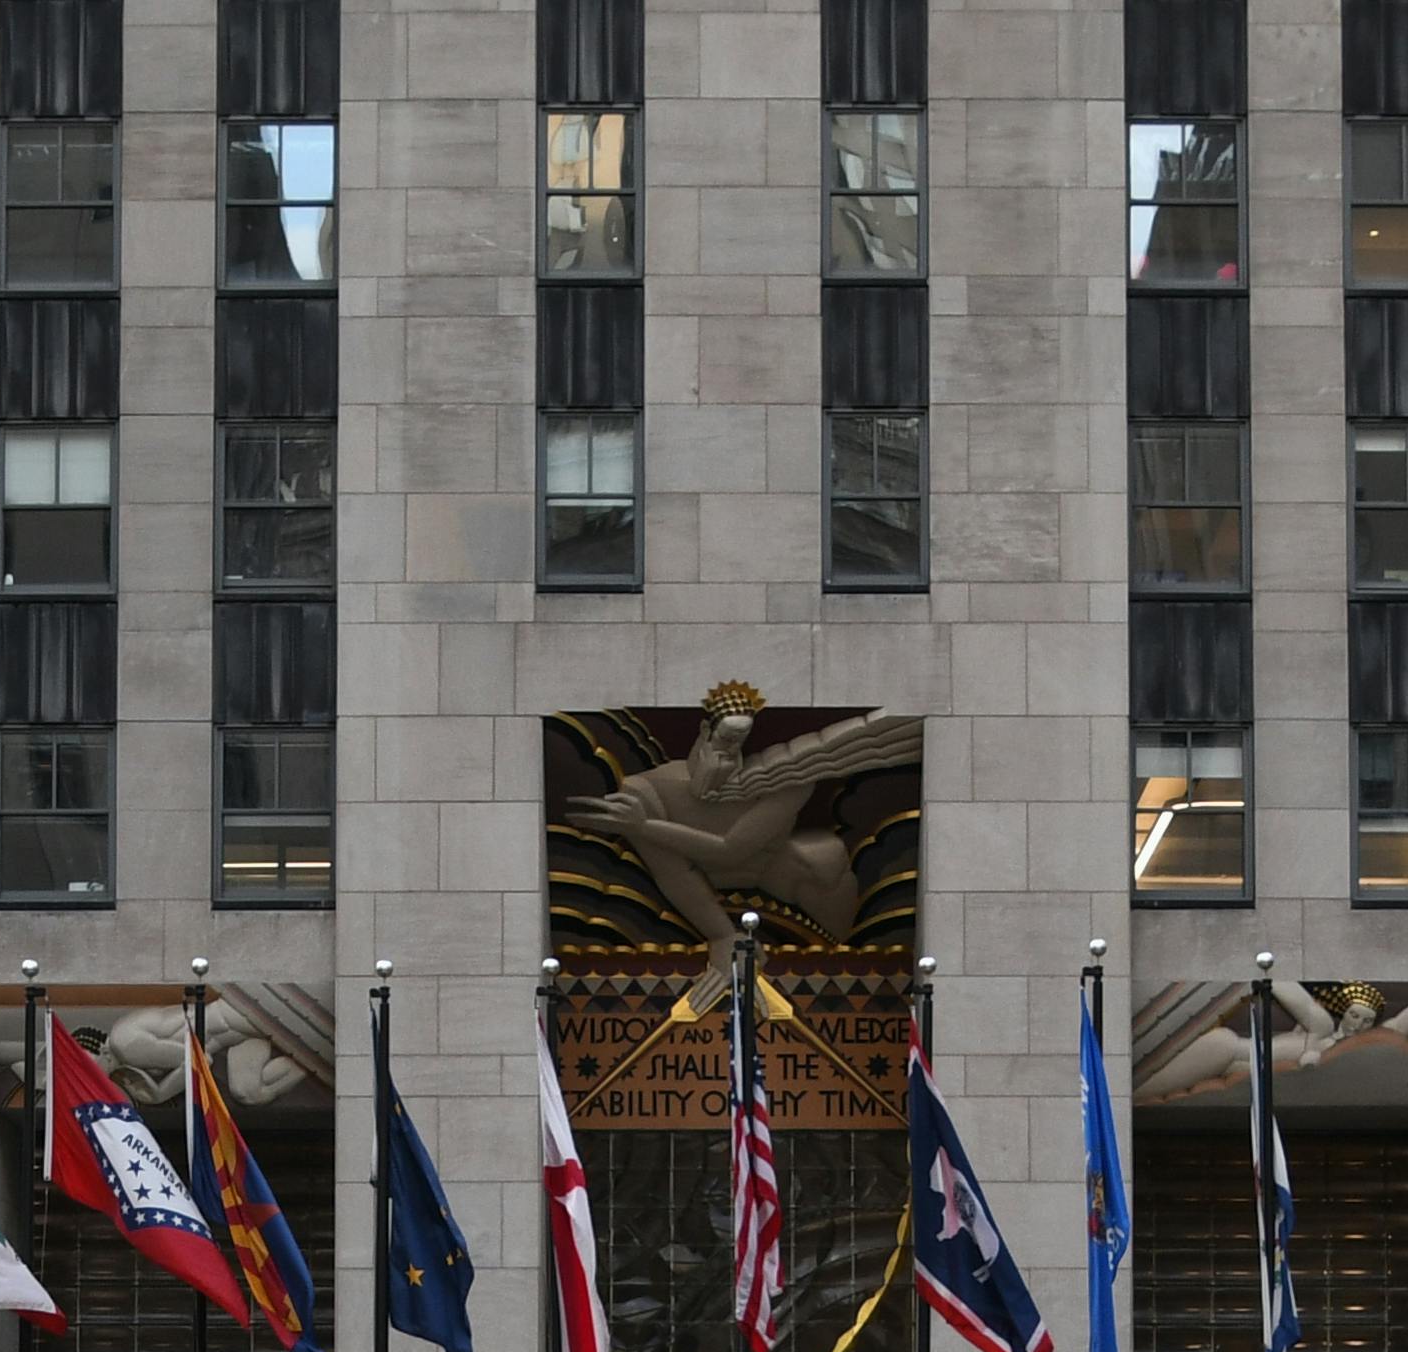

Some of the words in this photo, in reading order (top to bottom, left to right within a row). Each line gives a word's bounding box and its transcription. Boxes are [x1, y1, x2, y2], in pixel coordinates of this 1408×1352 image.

[681, 1028, 713, 1043] AND
[755, 1017, 910, 1044] KNWLEDGE
[646, 1053, 727, 1081] SHALL
[776, 1053, 819, 1081] THE
[561, 1089, 695, 1117] TABILITY
[700, 1089, 732, 1117] O
[121, 1133, 192, 1201] ARKANSAS
